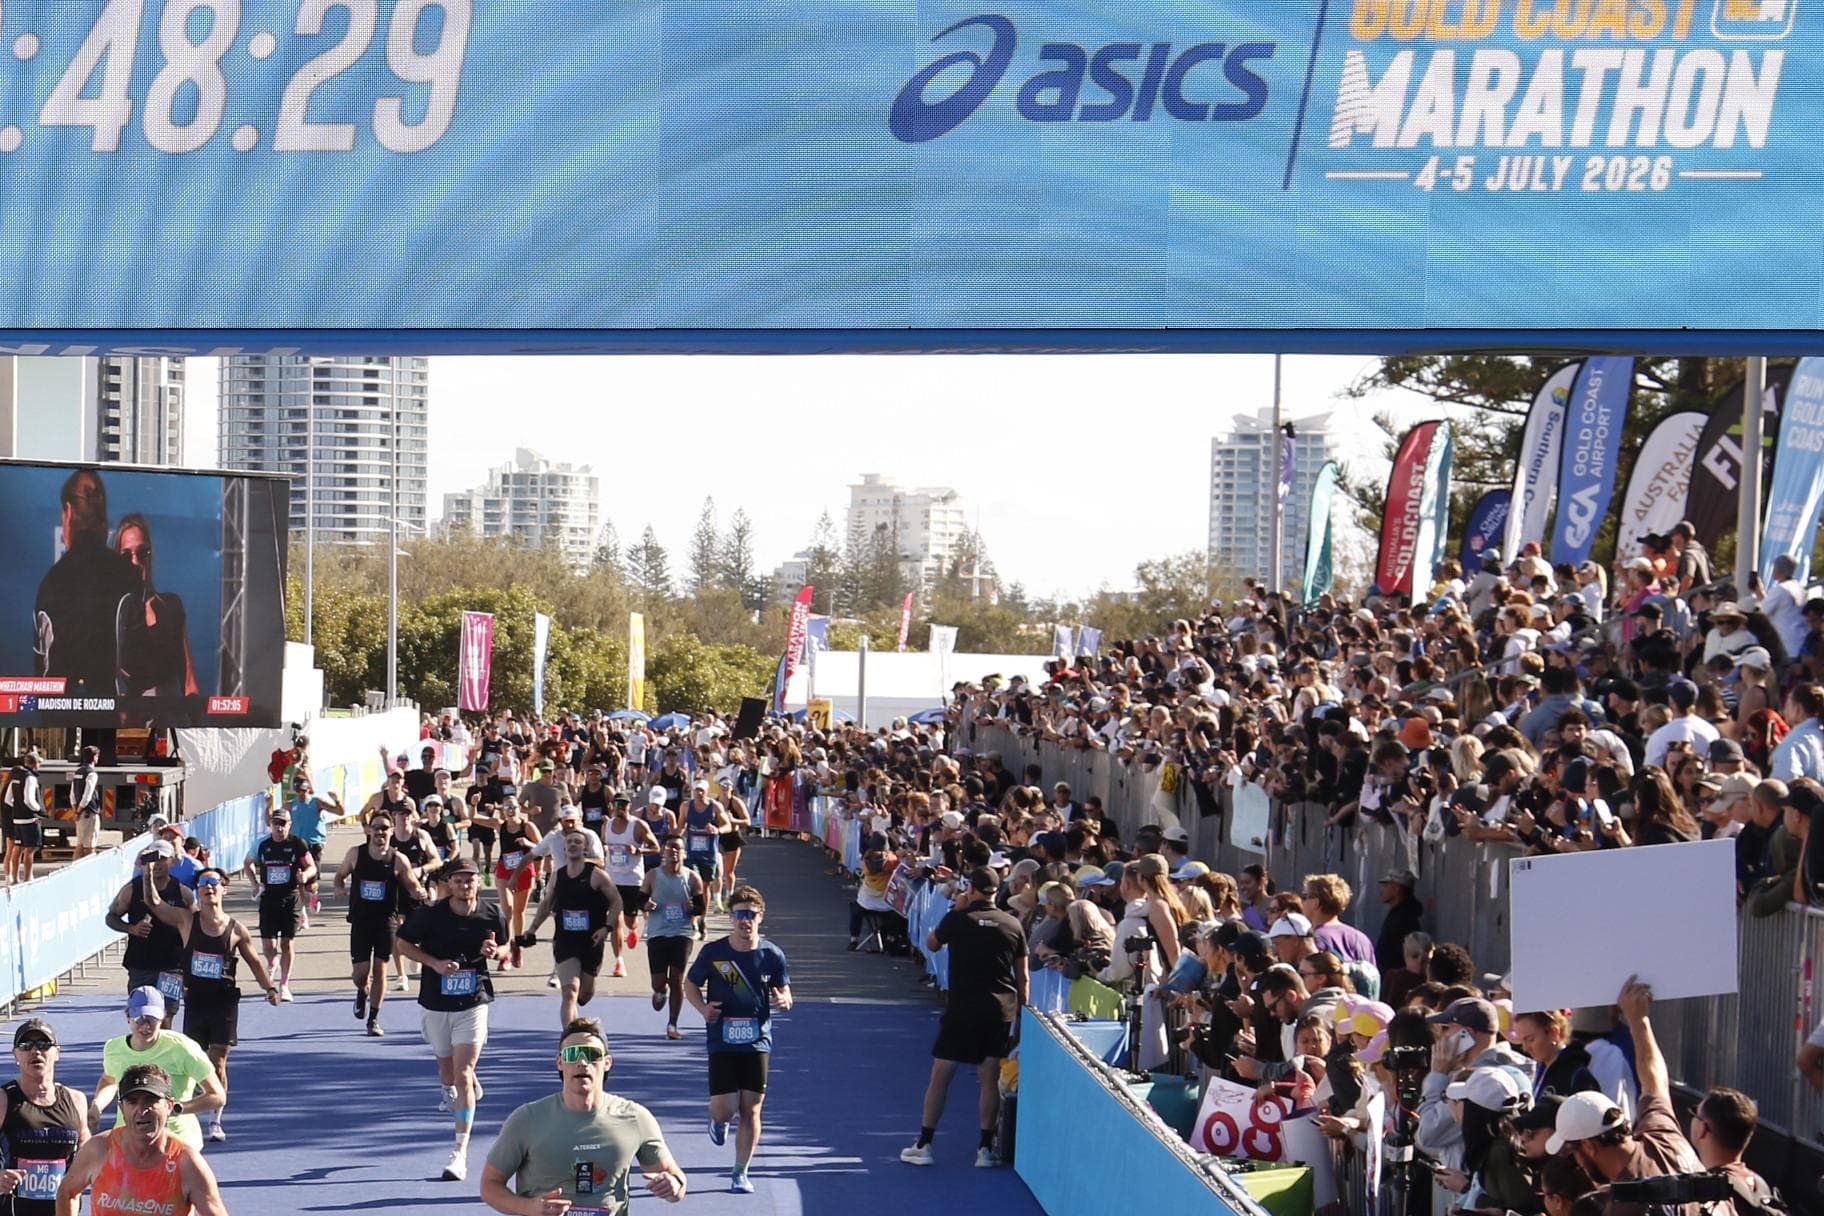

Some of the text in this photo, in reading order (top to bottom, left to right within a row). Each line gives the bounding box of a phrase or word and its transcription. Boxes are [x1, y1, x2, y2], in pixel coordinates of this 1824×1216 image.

[1327, 49, 1787, 148] MARATHON
[1414, 155, 1674, 192] 4-5 JULY 2026
[1526, 410, 1562, 486] Southern
[1574, 367, 1604, 478] GOLD COAST
[1589, 405, 1612, 478] AIRPORT
[1634, 422, 1704, 523] AUSTRALIA
[37, 697, 115, 711] MADISON DE ROZARIO
[211, 698, 242, 712] 01:57:05
